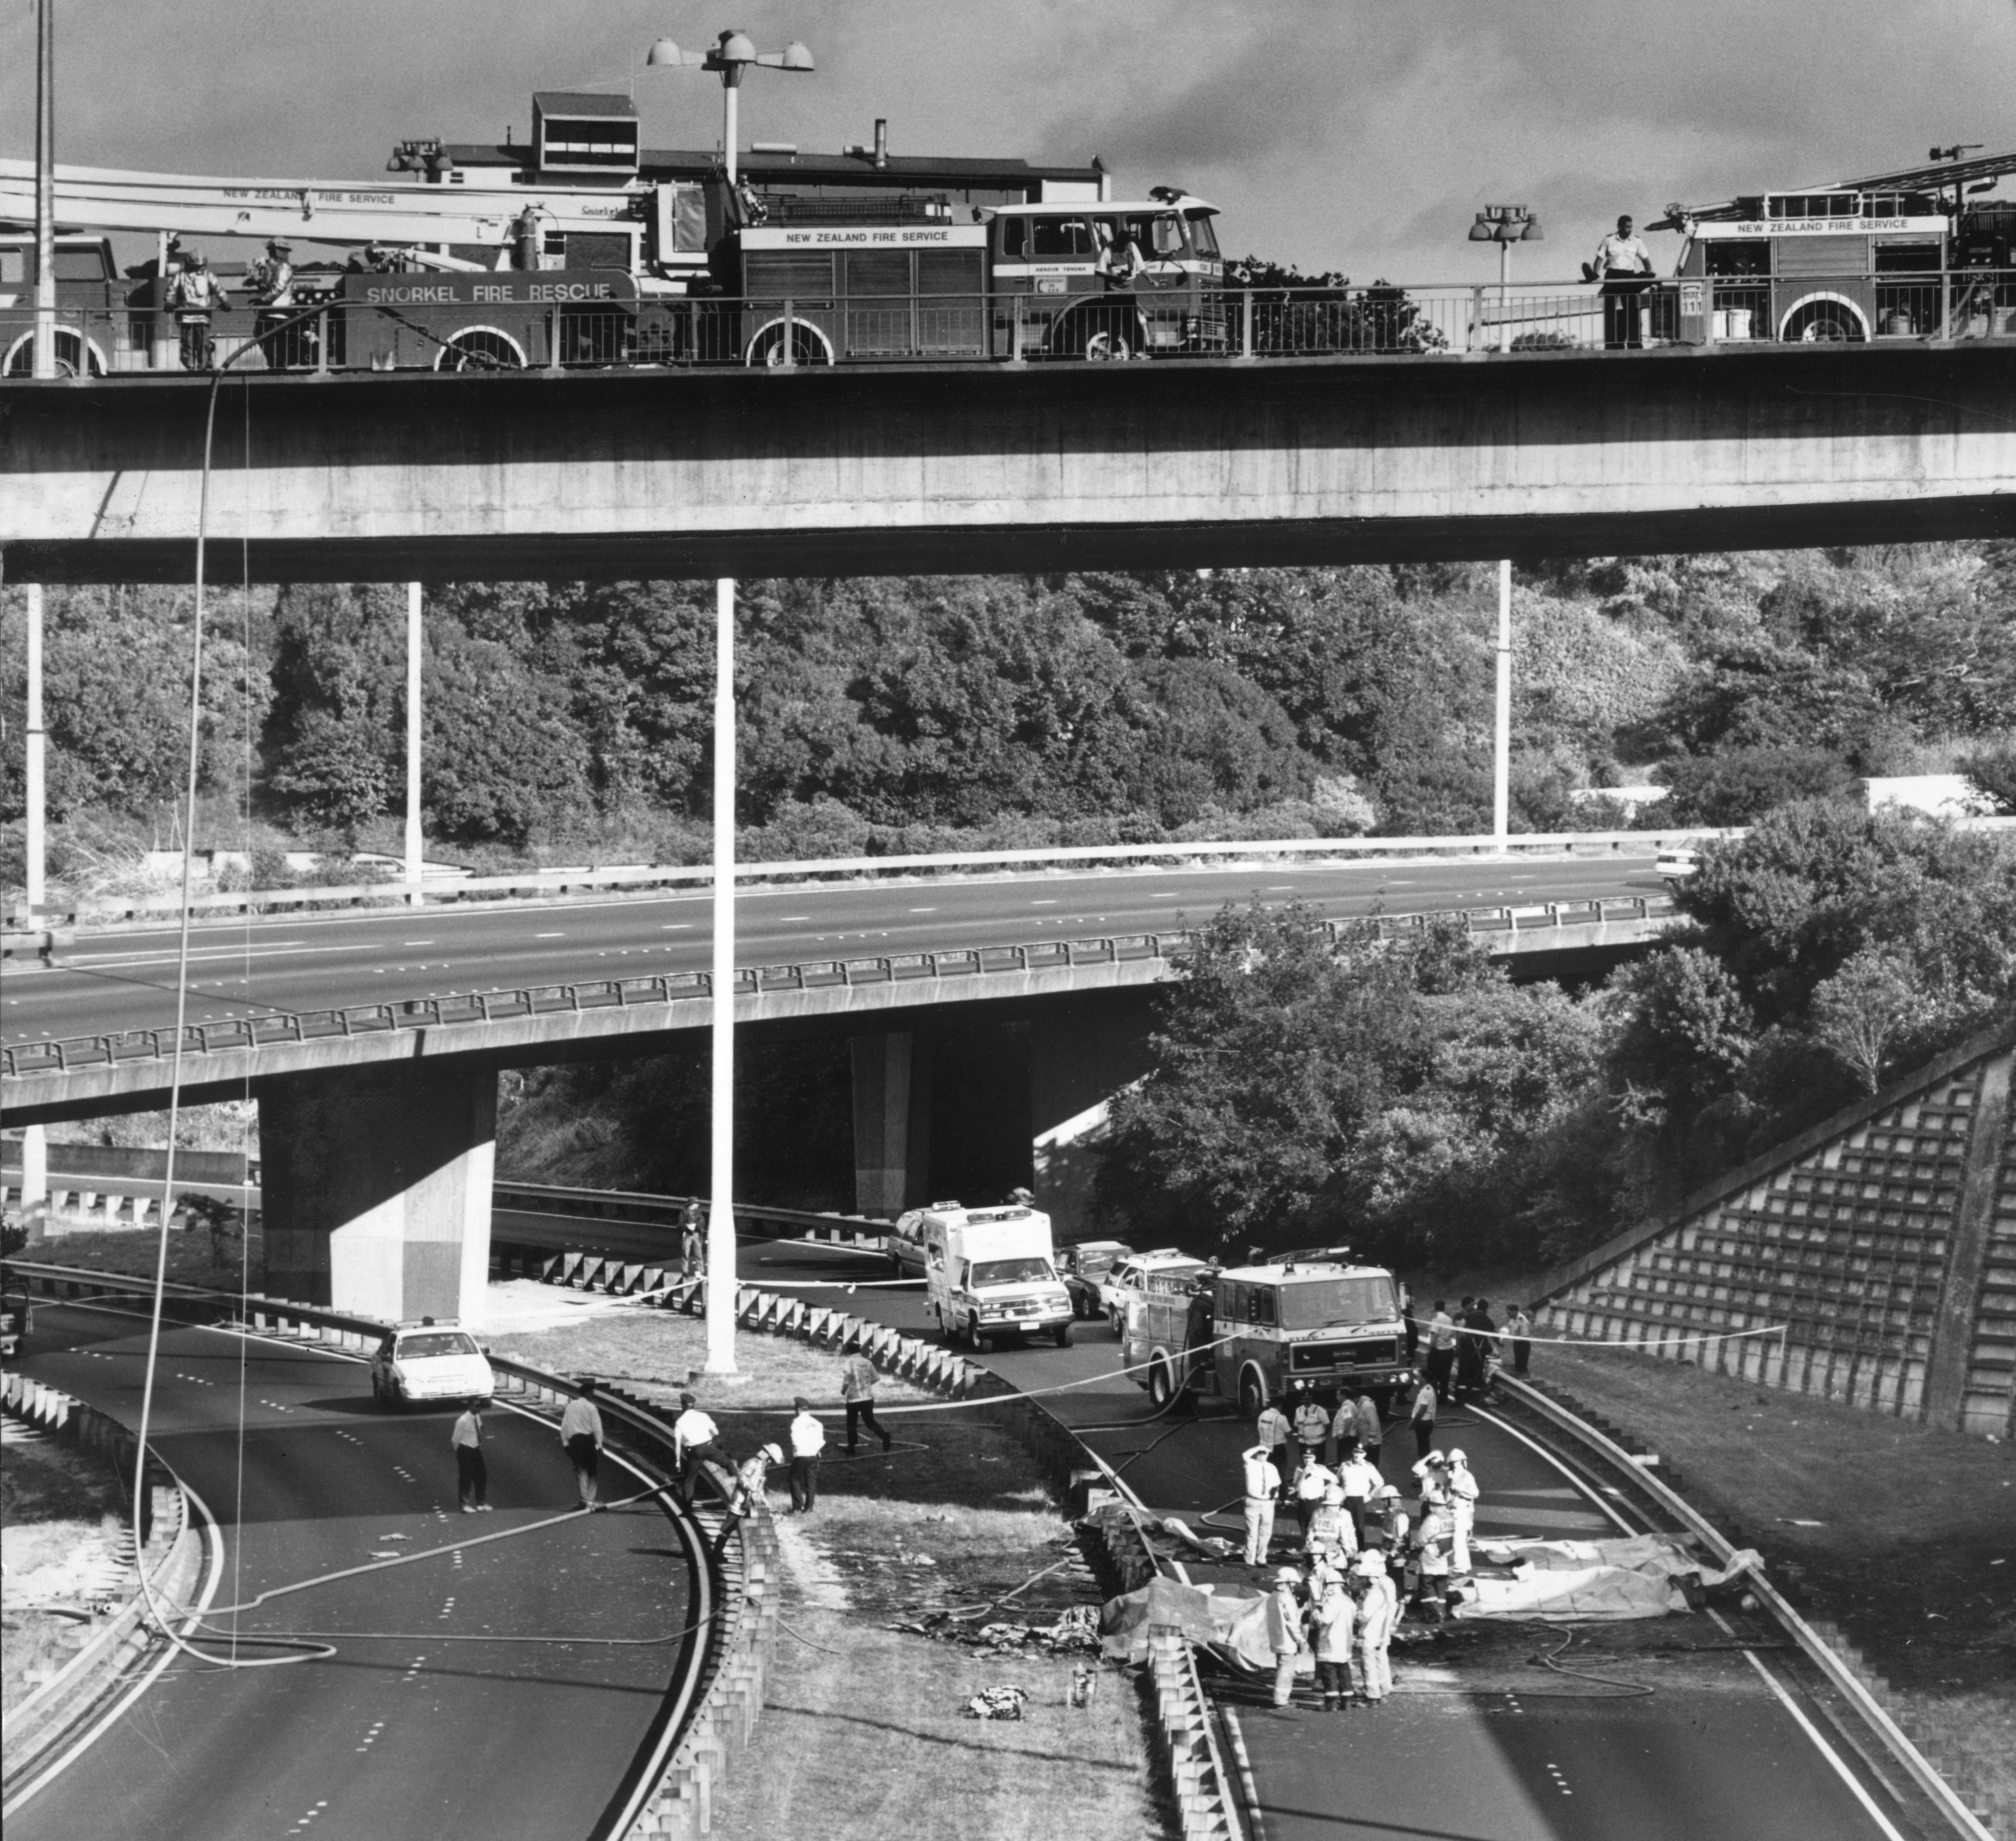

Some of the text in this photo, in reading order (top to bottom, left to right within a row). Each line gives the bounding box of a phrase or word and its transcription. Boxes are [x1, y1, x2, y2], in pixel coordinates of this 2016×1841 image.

[223, 188, 249, 198] NEW
[318, 192, 342, 202] FIRE
[349, 194, 395, 204] SERVICE
[1738, 219, 1908, 233] NEW ZEALAND FIRE SERVICE
[786, 231, 948, 242] NEW ZEALAND FIRE SERVICE
[367, 283, 610, 303] SNORKEL FIRE RESCUE
[1683, 301, 1701, 312] 111
